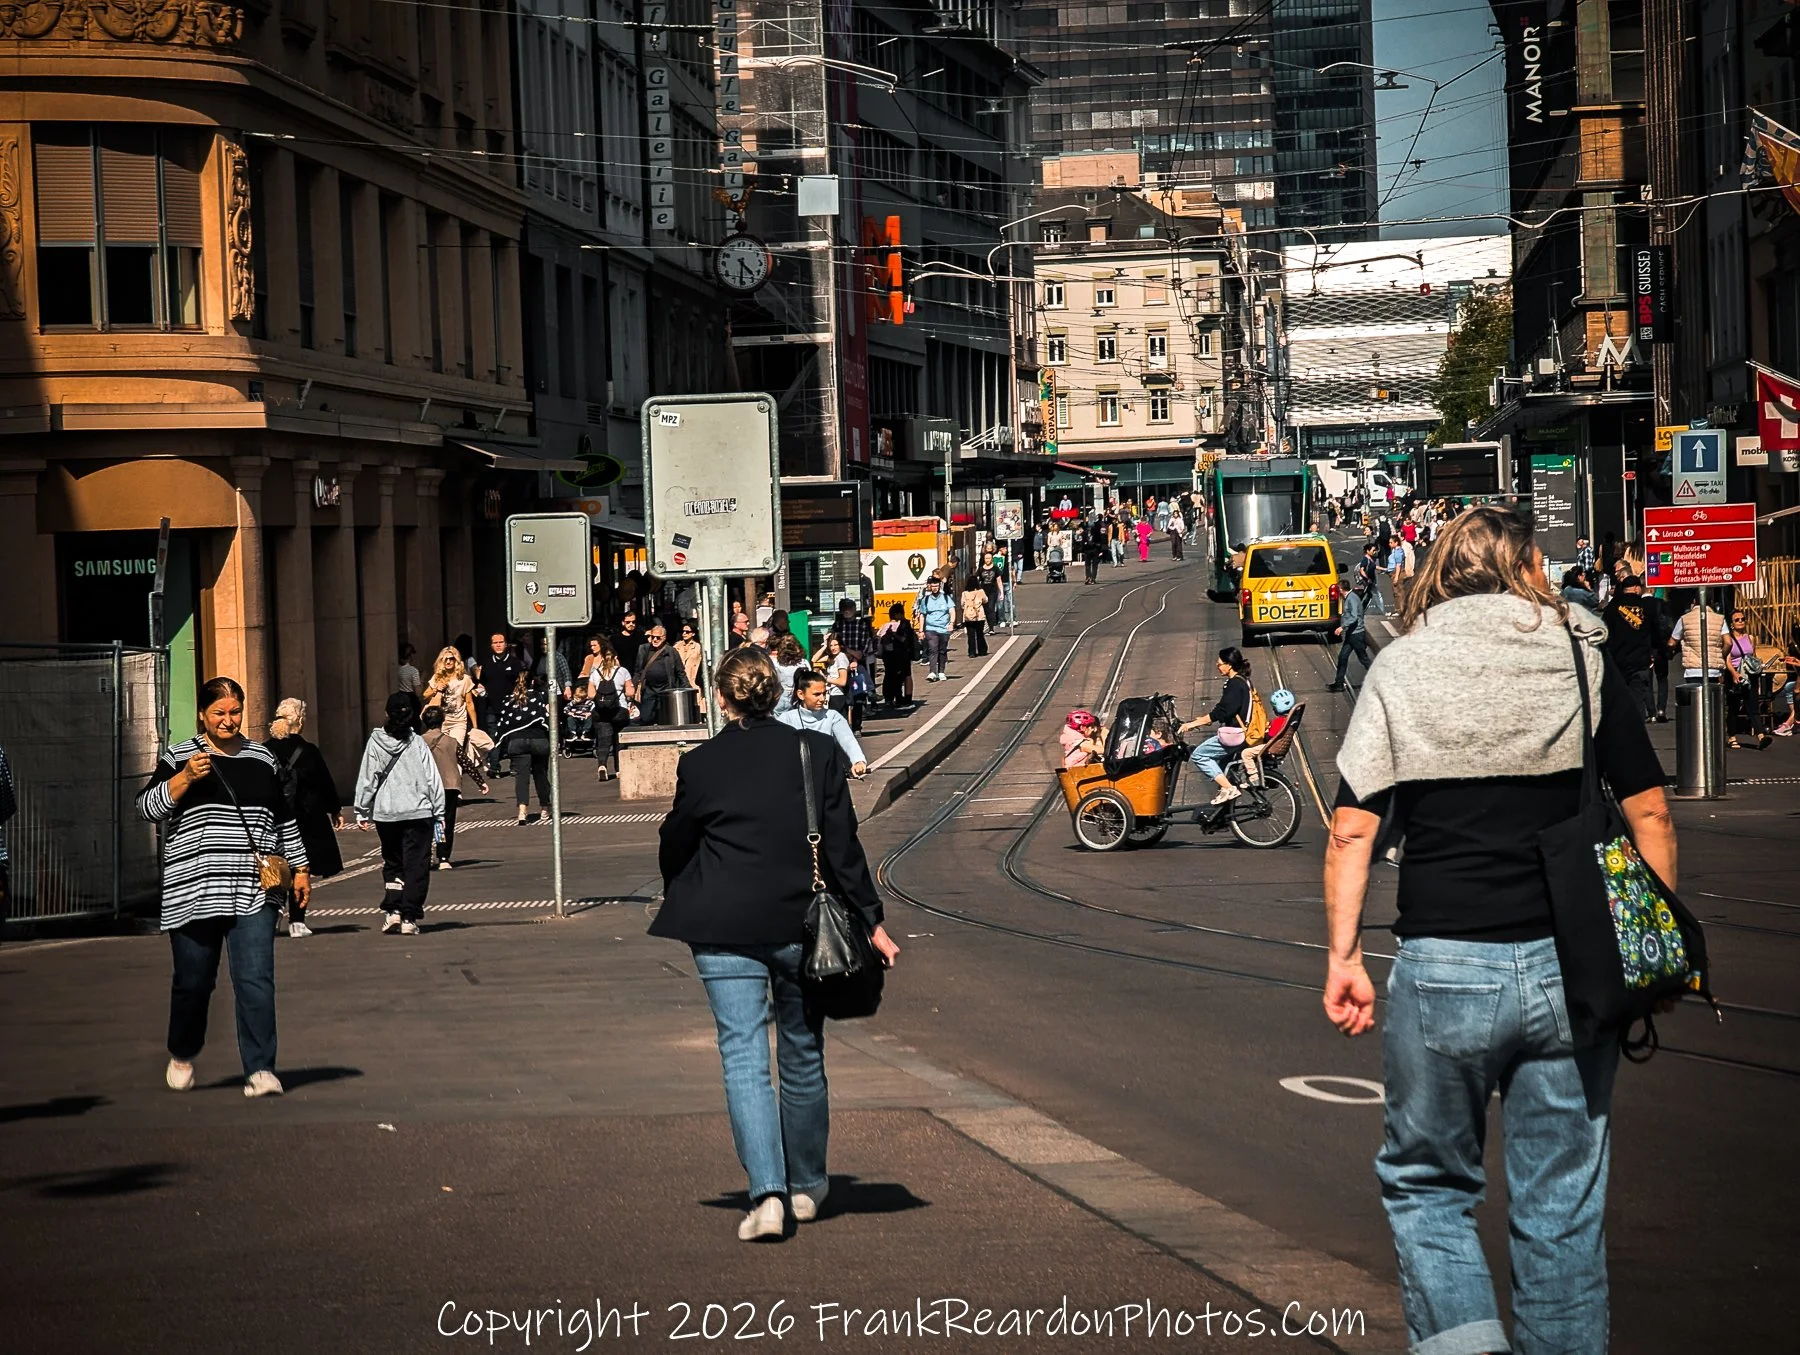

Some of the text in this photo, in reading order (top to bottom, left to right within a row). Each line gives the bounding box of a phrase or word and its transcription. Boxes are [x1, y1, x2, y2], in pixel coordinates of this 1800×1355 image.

[1523, 27, 1543, 123] MANOR
[648, 69, 669, 225] Galerie
[1637, 250, 1652, 295] (SUISSE)
[1046, 374, 1056, 441] COPACABANA
[661, 414, 678, 424] MPZ
[1662, 530, 1683, 538] Lörrach
[74, 558, 156, 577] SAMSUNG
[1673, 560, 1696, 568] Pratteln
[1673, 568, 1687, 576] Weil
[1674, 574, 1722, 583] Grenzach-Wyhlen
[876, 599, 907, 608] Meter
[1258, 603, 1325, 621] POLIZEI
